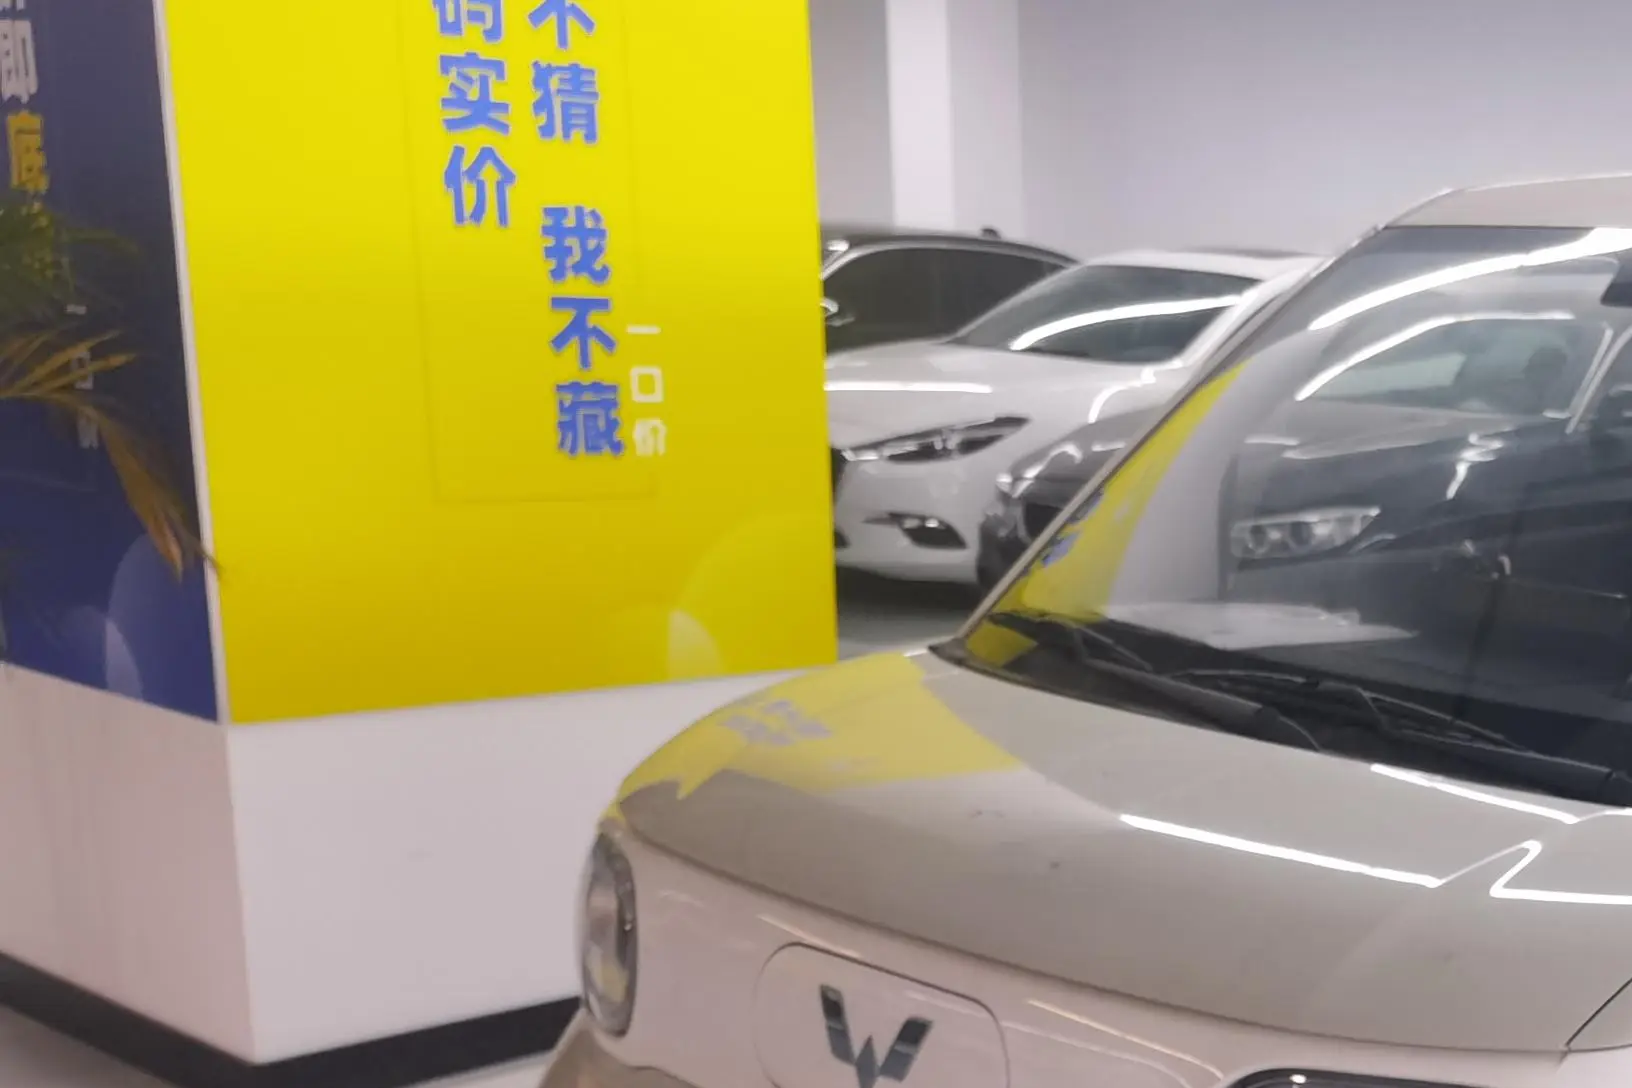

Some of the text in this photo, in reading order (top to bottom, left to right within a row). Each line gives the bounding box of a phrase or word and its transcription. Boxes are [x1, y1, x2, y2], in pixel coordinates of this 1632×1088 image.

[540, 204, 625, 459] 我不藏
[625, 322, 668, 457] 一口价
